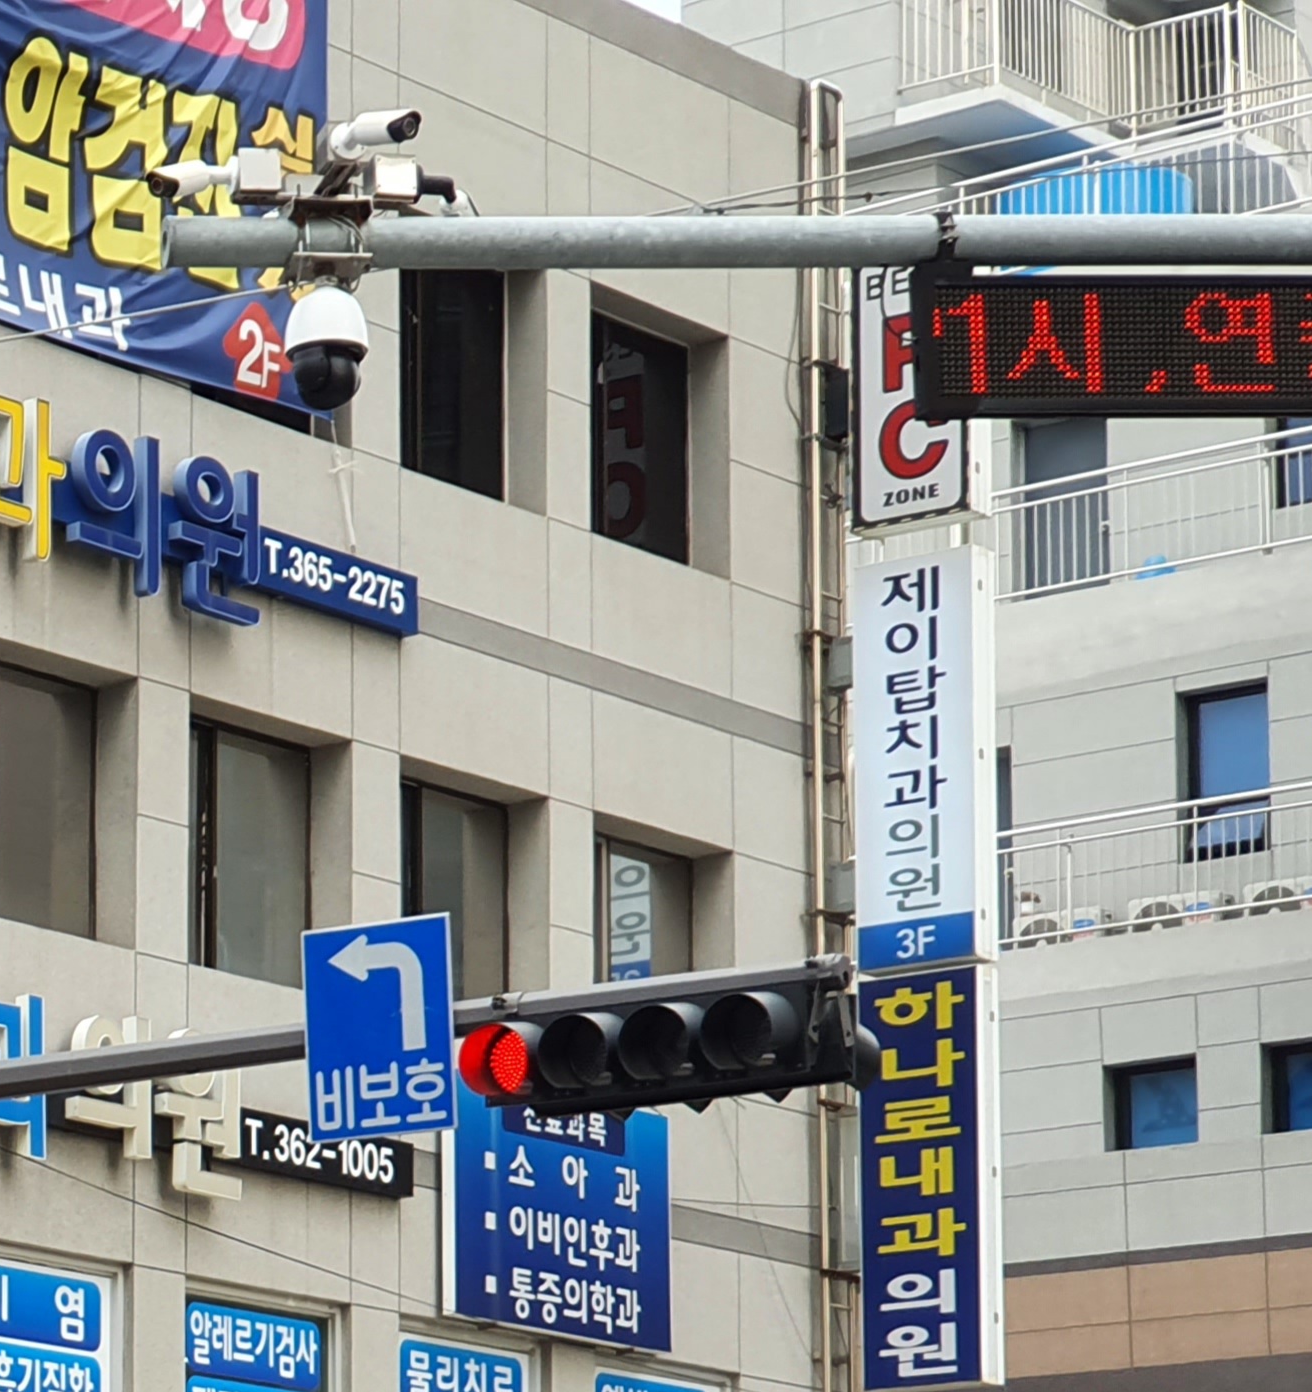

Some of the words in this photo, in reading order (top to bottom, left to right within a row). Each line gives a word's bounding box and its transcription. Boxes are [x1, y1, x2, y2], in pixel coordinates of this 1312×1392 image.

[237, 319, 280, 389] 2F
[883, 483, 940, 507] ZONE
[880, 565, 948, 913] 제이탑치과의원
[895, 925, 936, 959] 3F
[315, 1058, 448, 1133] 비보호
[873, 981, 968, 1378] 하나로내과의원
[508, 1205, 641, 1273] 이비인후과
[508, 1266, 642, 1335] 통증의학과
[190, 1309, 318, 1380] 알레르기검사
